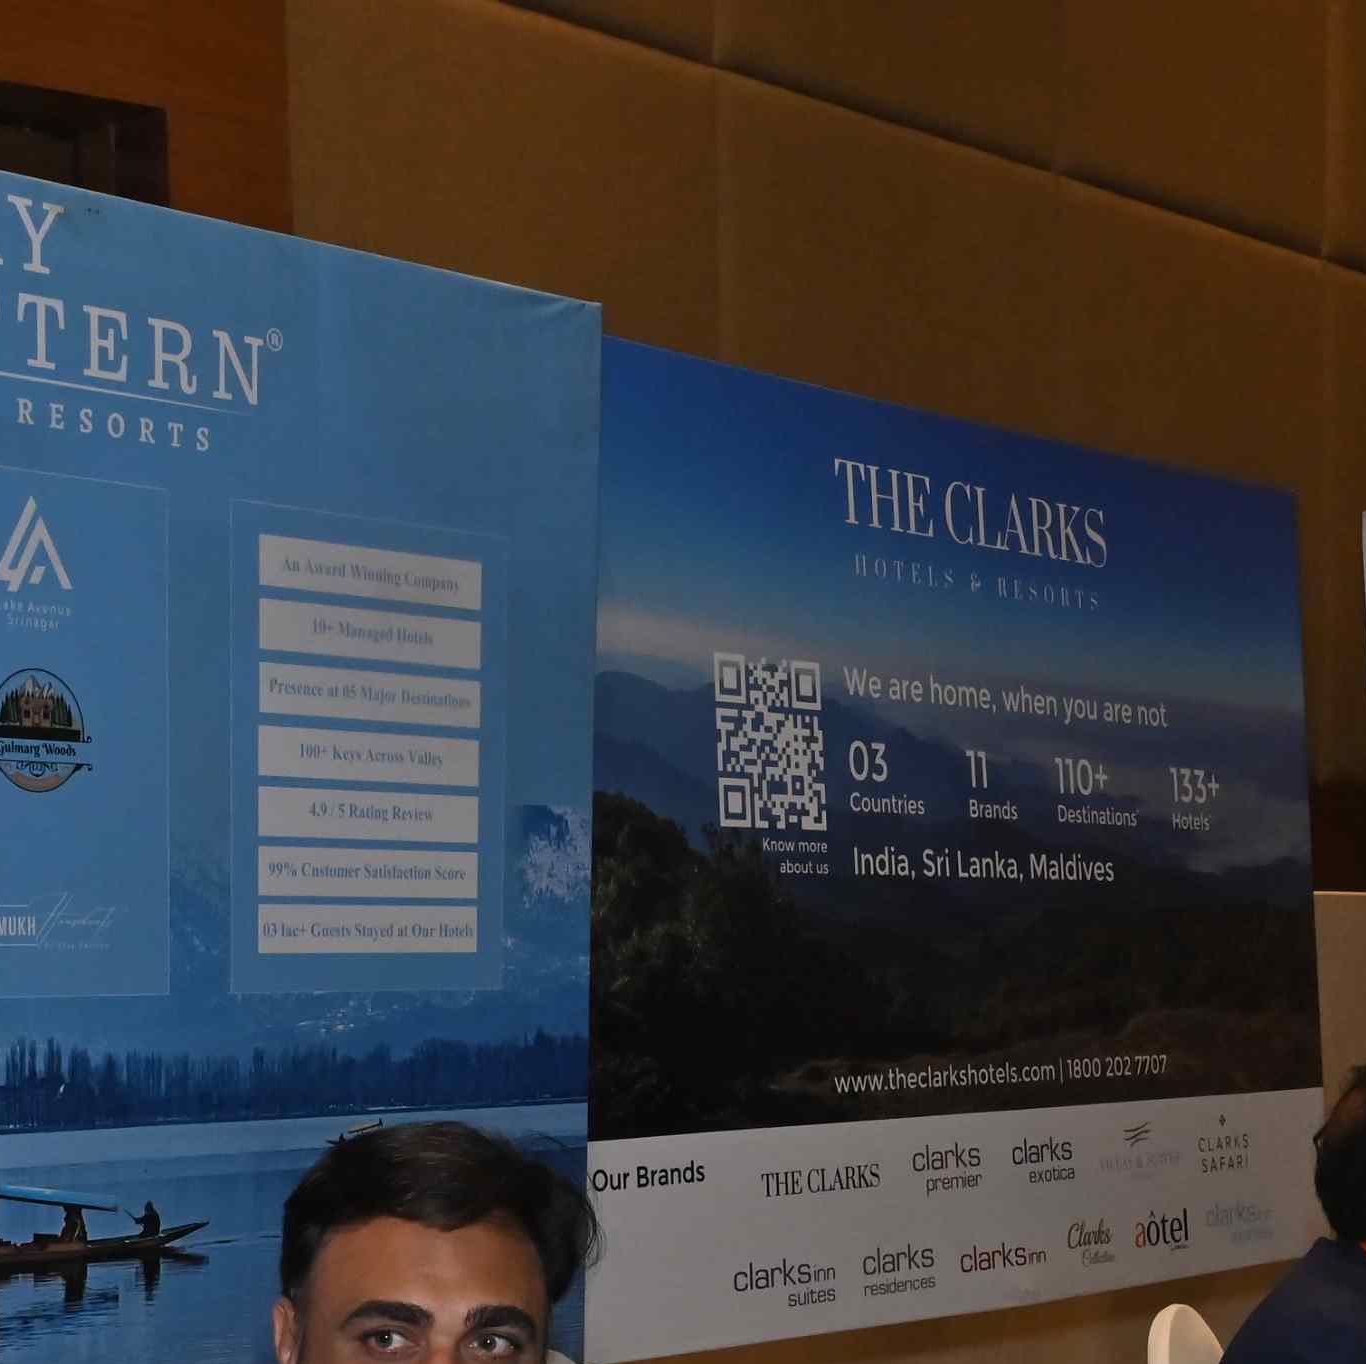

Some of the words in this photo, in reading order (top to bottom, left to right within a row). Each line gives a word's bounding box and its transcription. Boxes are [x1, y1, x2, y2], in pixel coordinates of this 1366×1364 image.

[18, 398, 211, 452] RESORTS
[834, 458, 935, 537] THE
[944, 480, 1108, 568] CLARKS
[304, 559, 347, 579] Award
[351, 564, 401, 588] Winning
[403, 571, 460, 596] Company
[853, 552, 955, 589] HOTELS
[997, 575, 1100, 611] RESORTS
[269, 677, 324, 698] Presence
[843, 666, 882, 698] We
[889, 677, 924, 701] are
[929, 674, 997, 714] home,
[1002, 685, 1058, 717] when
[1062, 697, 1098, 725] you
[1103, 701, 1132, 724] are
[1138, 701, 1168, 728] not
[42, 743, 76, 758] Woods
[366, 747, 405, 765] Across
[848, 740, 889, 782] 03
[965, 749, 988, 789] 11
[1054, 757, 1108, 796] 110+
[1169, 767, 1220, 804] 133+
[348, 803, 389, 824] Rating
[392, 805, 434, 822] Review
[850, 791, 925, 815] Countries
[969, 799, 1019, 820] Brands
[762, 837, 795, 853] Know
[798, 840, 828, 853] more
[268, 861, 298, 879] 99%
[301, 862, 362, 881] Customer
[363, 863, 432, 882] Satisfaction
[435, 865, 467, 882] Score
[779, 859, 813, 874] about
[816, 862, 829, 874] us
[853, 845, 916, 880] India,
[922, 847, 950, 878] Sri
[957, 849, 1023, 882] Lanka,
[1029, 852, 1115, 882] Maldives
[355, 922, 394, 943] Stayed
[411, 923, 436, 939] Our
[834, 1060, 1056, 1095] www.theclarkshotels.com
[1066, 1056, 1102, 1081] 1800
[1106, 1055, 1131, 1078] 202
[1135, 1053, 1168, 1075] 7707
[912, 1142, 982, 1172] clarks
[1012, 1136, 1073, 1166] clarks
[1197, 1132, 1251, 1152] CLARKS
[592, 1169, 630, 1192] Our
[636, 1160, 706, 1188] Brands
[1029, 1166, 1076, 1185] exotica
[1201, 1153, 1250, 1174] SAFARI
[761, 1170, 804, 1199] THE
[807, 1163, 882, 1194] CLARKS
[926, 1173, 983, 1198] premier
[1067, 1218, 1113, 1250] Clarks
[862, 1243, 935, 1276] clarks
[788, 1287, 836, 1307] suites
[864, 1275, 936, 1297] residences
